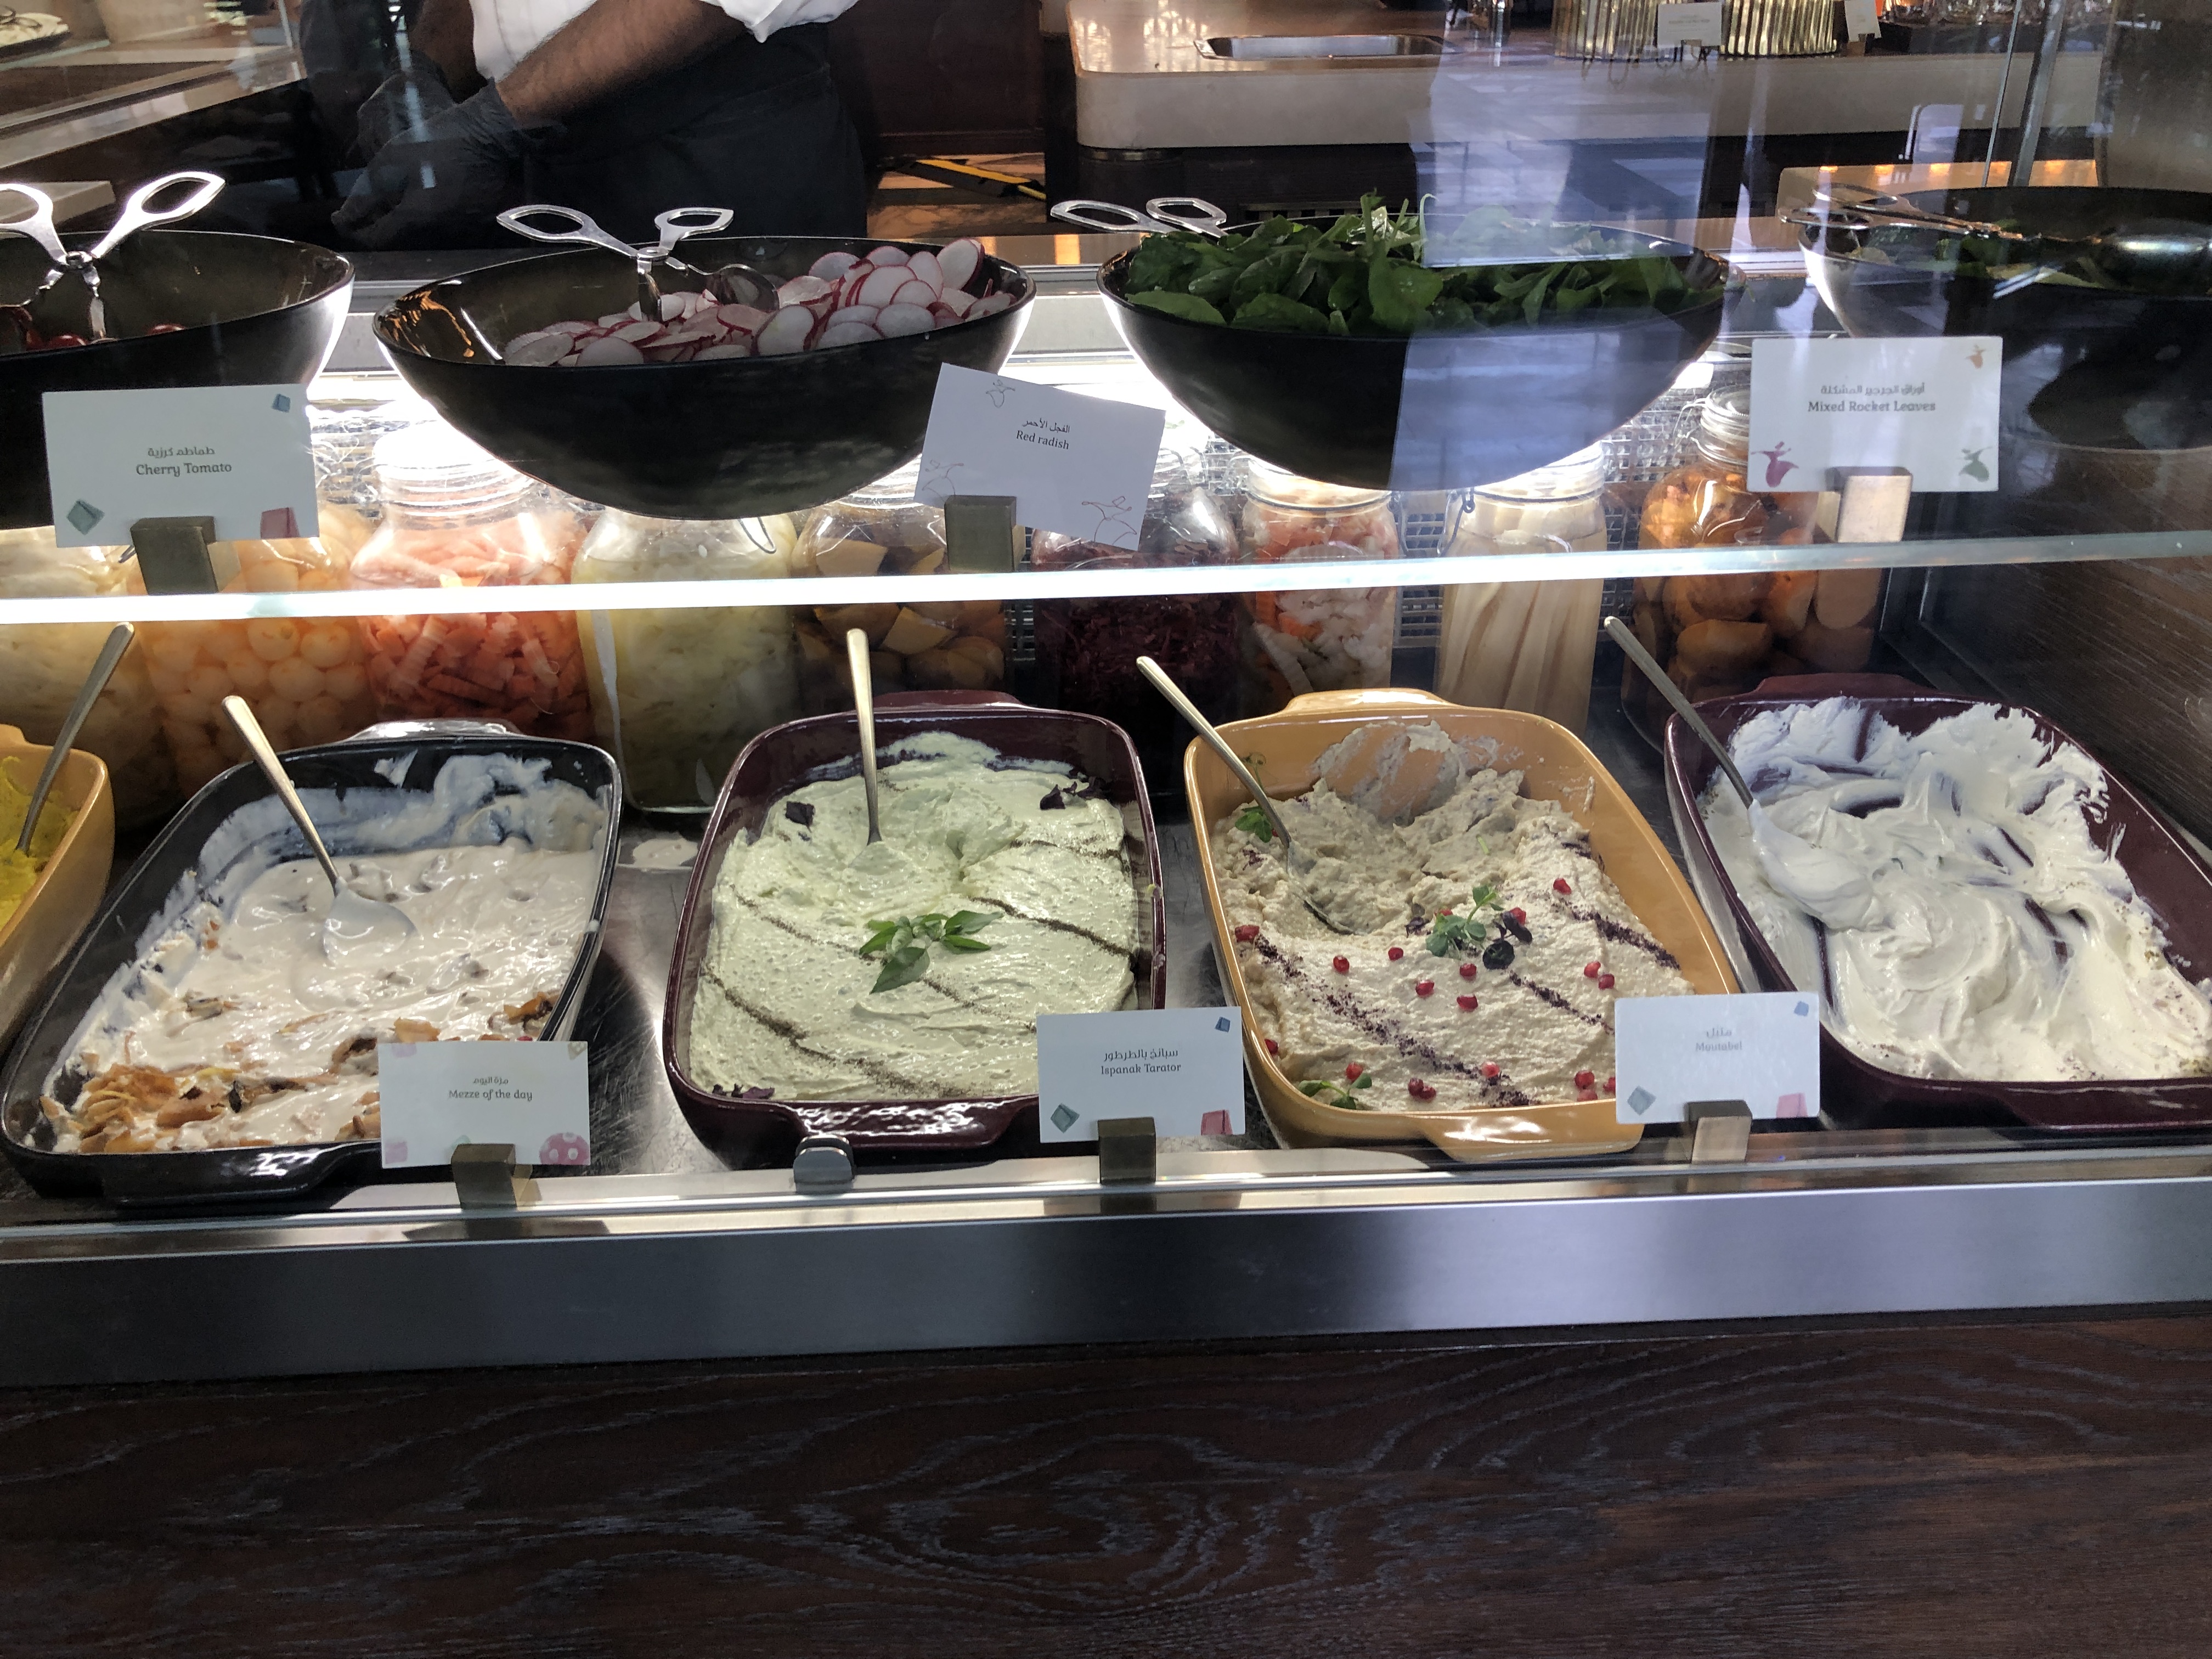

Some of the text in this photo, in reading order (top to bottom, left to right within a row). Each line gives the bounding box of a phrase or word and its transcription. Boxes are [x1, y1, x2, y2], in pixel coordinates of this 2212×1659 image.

[1808, 400, 1936, 412] Mixed Rocket Leaves
[1022, 417, 1070, 433] الفجل الأحمر
[1016, 430, 1069, 450] Red radish
[176, 446, 216, 456] طماطم
[137, 462, 232, 477] Cherry Tomato
[1101, 1063, 1182, 1077] Ispanak Tarator
[449, 1089, 532, 1102] Mezze of the day
